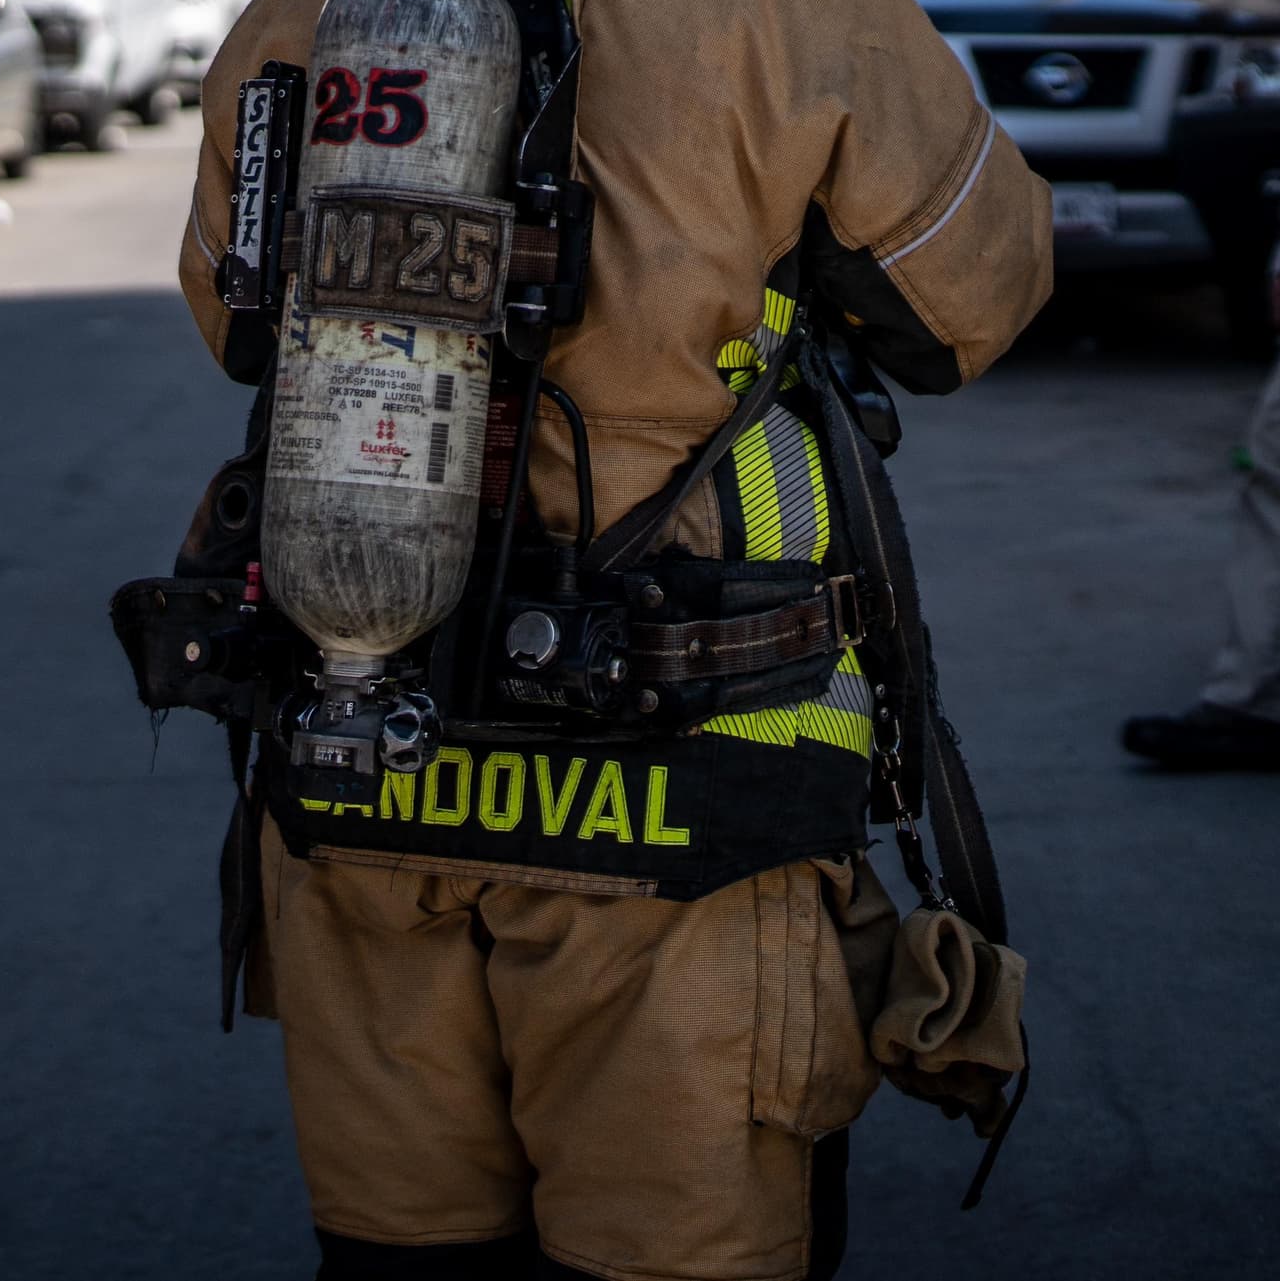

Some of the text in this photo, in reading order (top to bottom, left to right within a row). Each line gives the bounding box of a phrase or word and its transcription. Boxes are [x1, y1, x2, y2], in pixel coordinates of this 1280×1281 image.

[310, 67, 429, 147] 25
[240, 93, 270, 248] SCOTT
[315, 208, 497, 303] M 25
[384, 391, 424, 404] LUXFER
[360, 440, 408, 457] Luxfer
